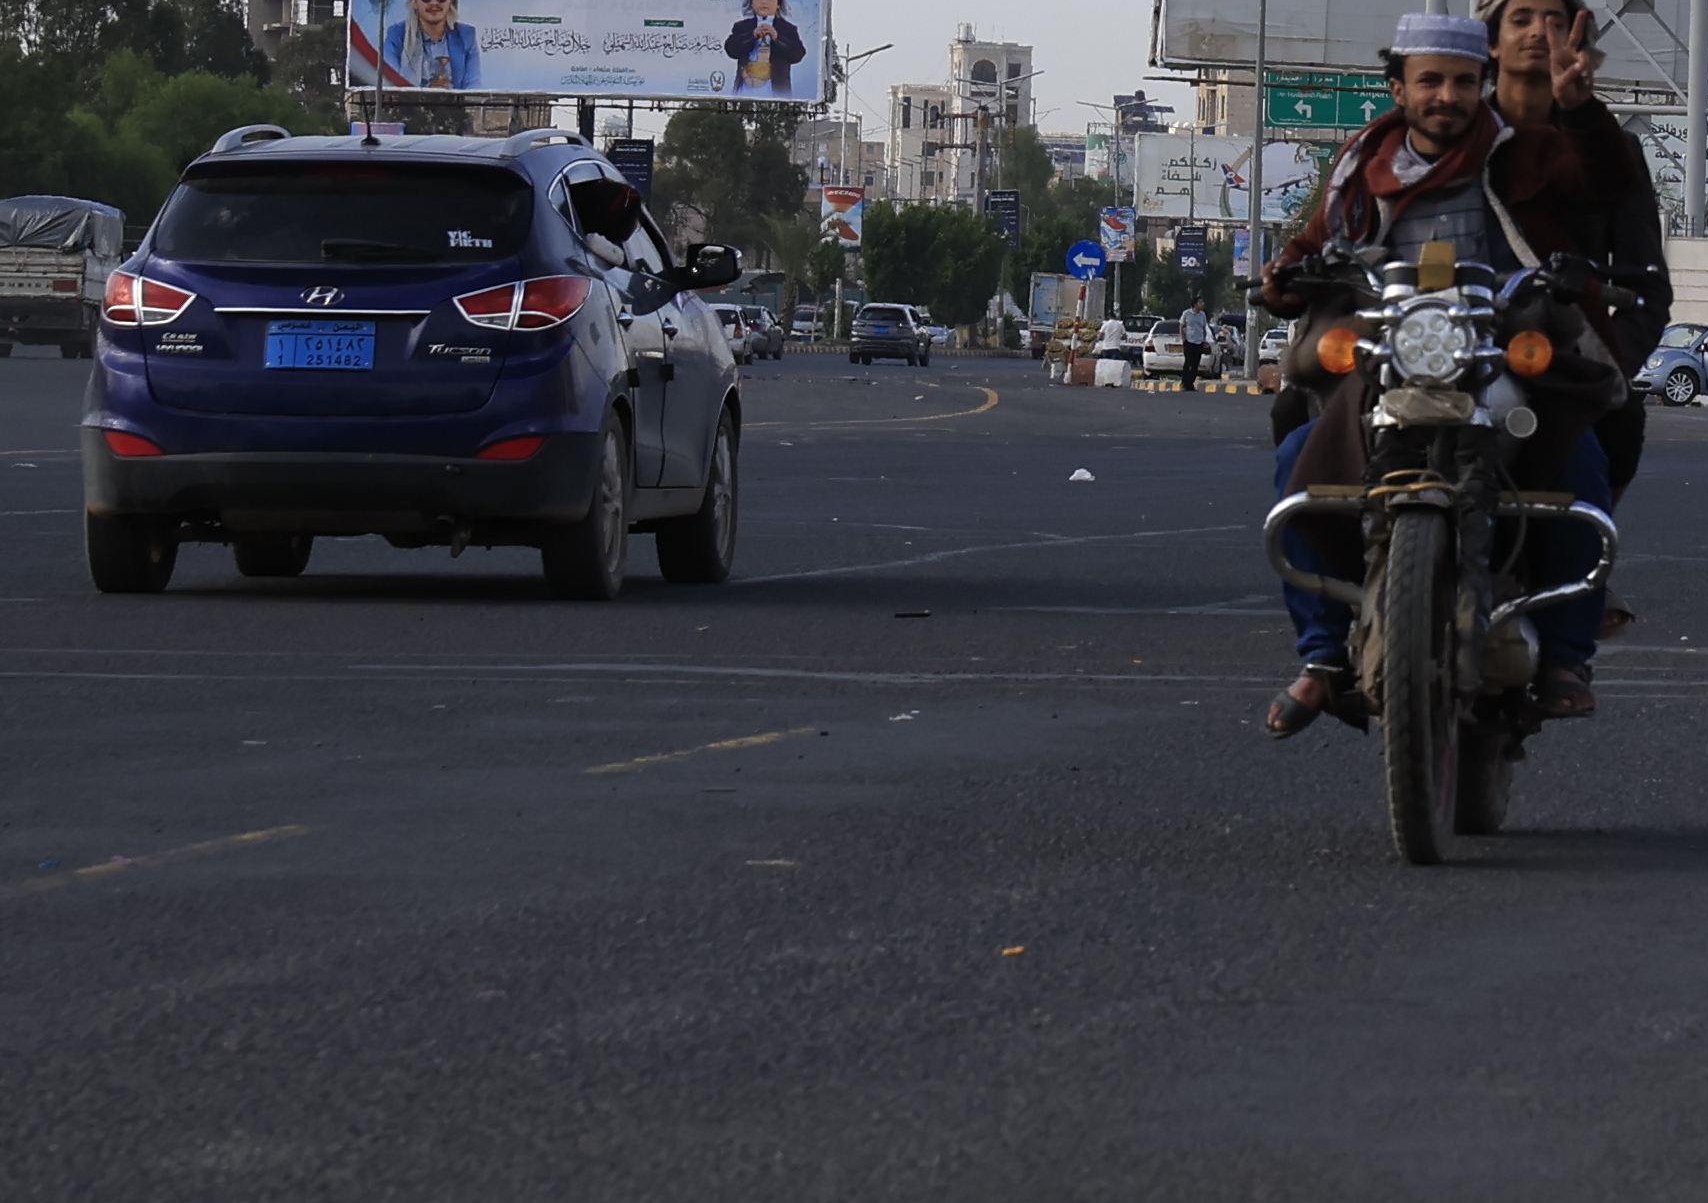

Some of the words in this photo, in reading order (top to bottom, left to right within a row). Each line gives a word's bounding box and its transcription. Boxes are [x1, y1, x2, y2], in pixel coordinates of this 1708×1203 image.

[305, 336, 365, 352] ٢٥١٤٨٢
[277, 354, 284, 365] 1
[306, 354, 362, 366] 251482
